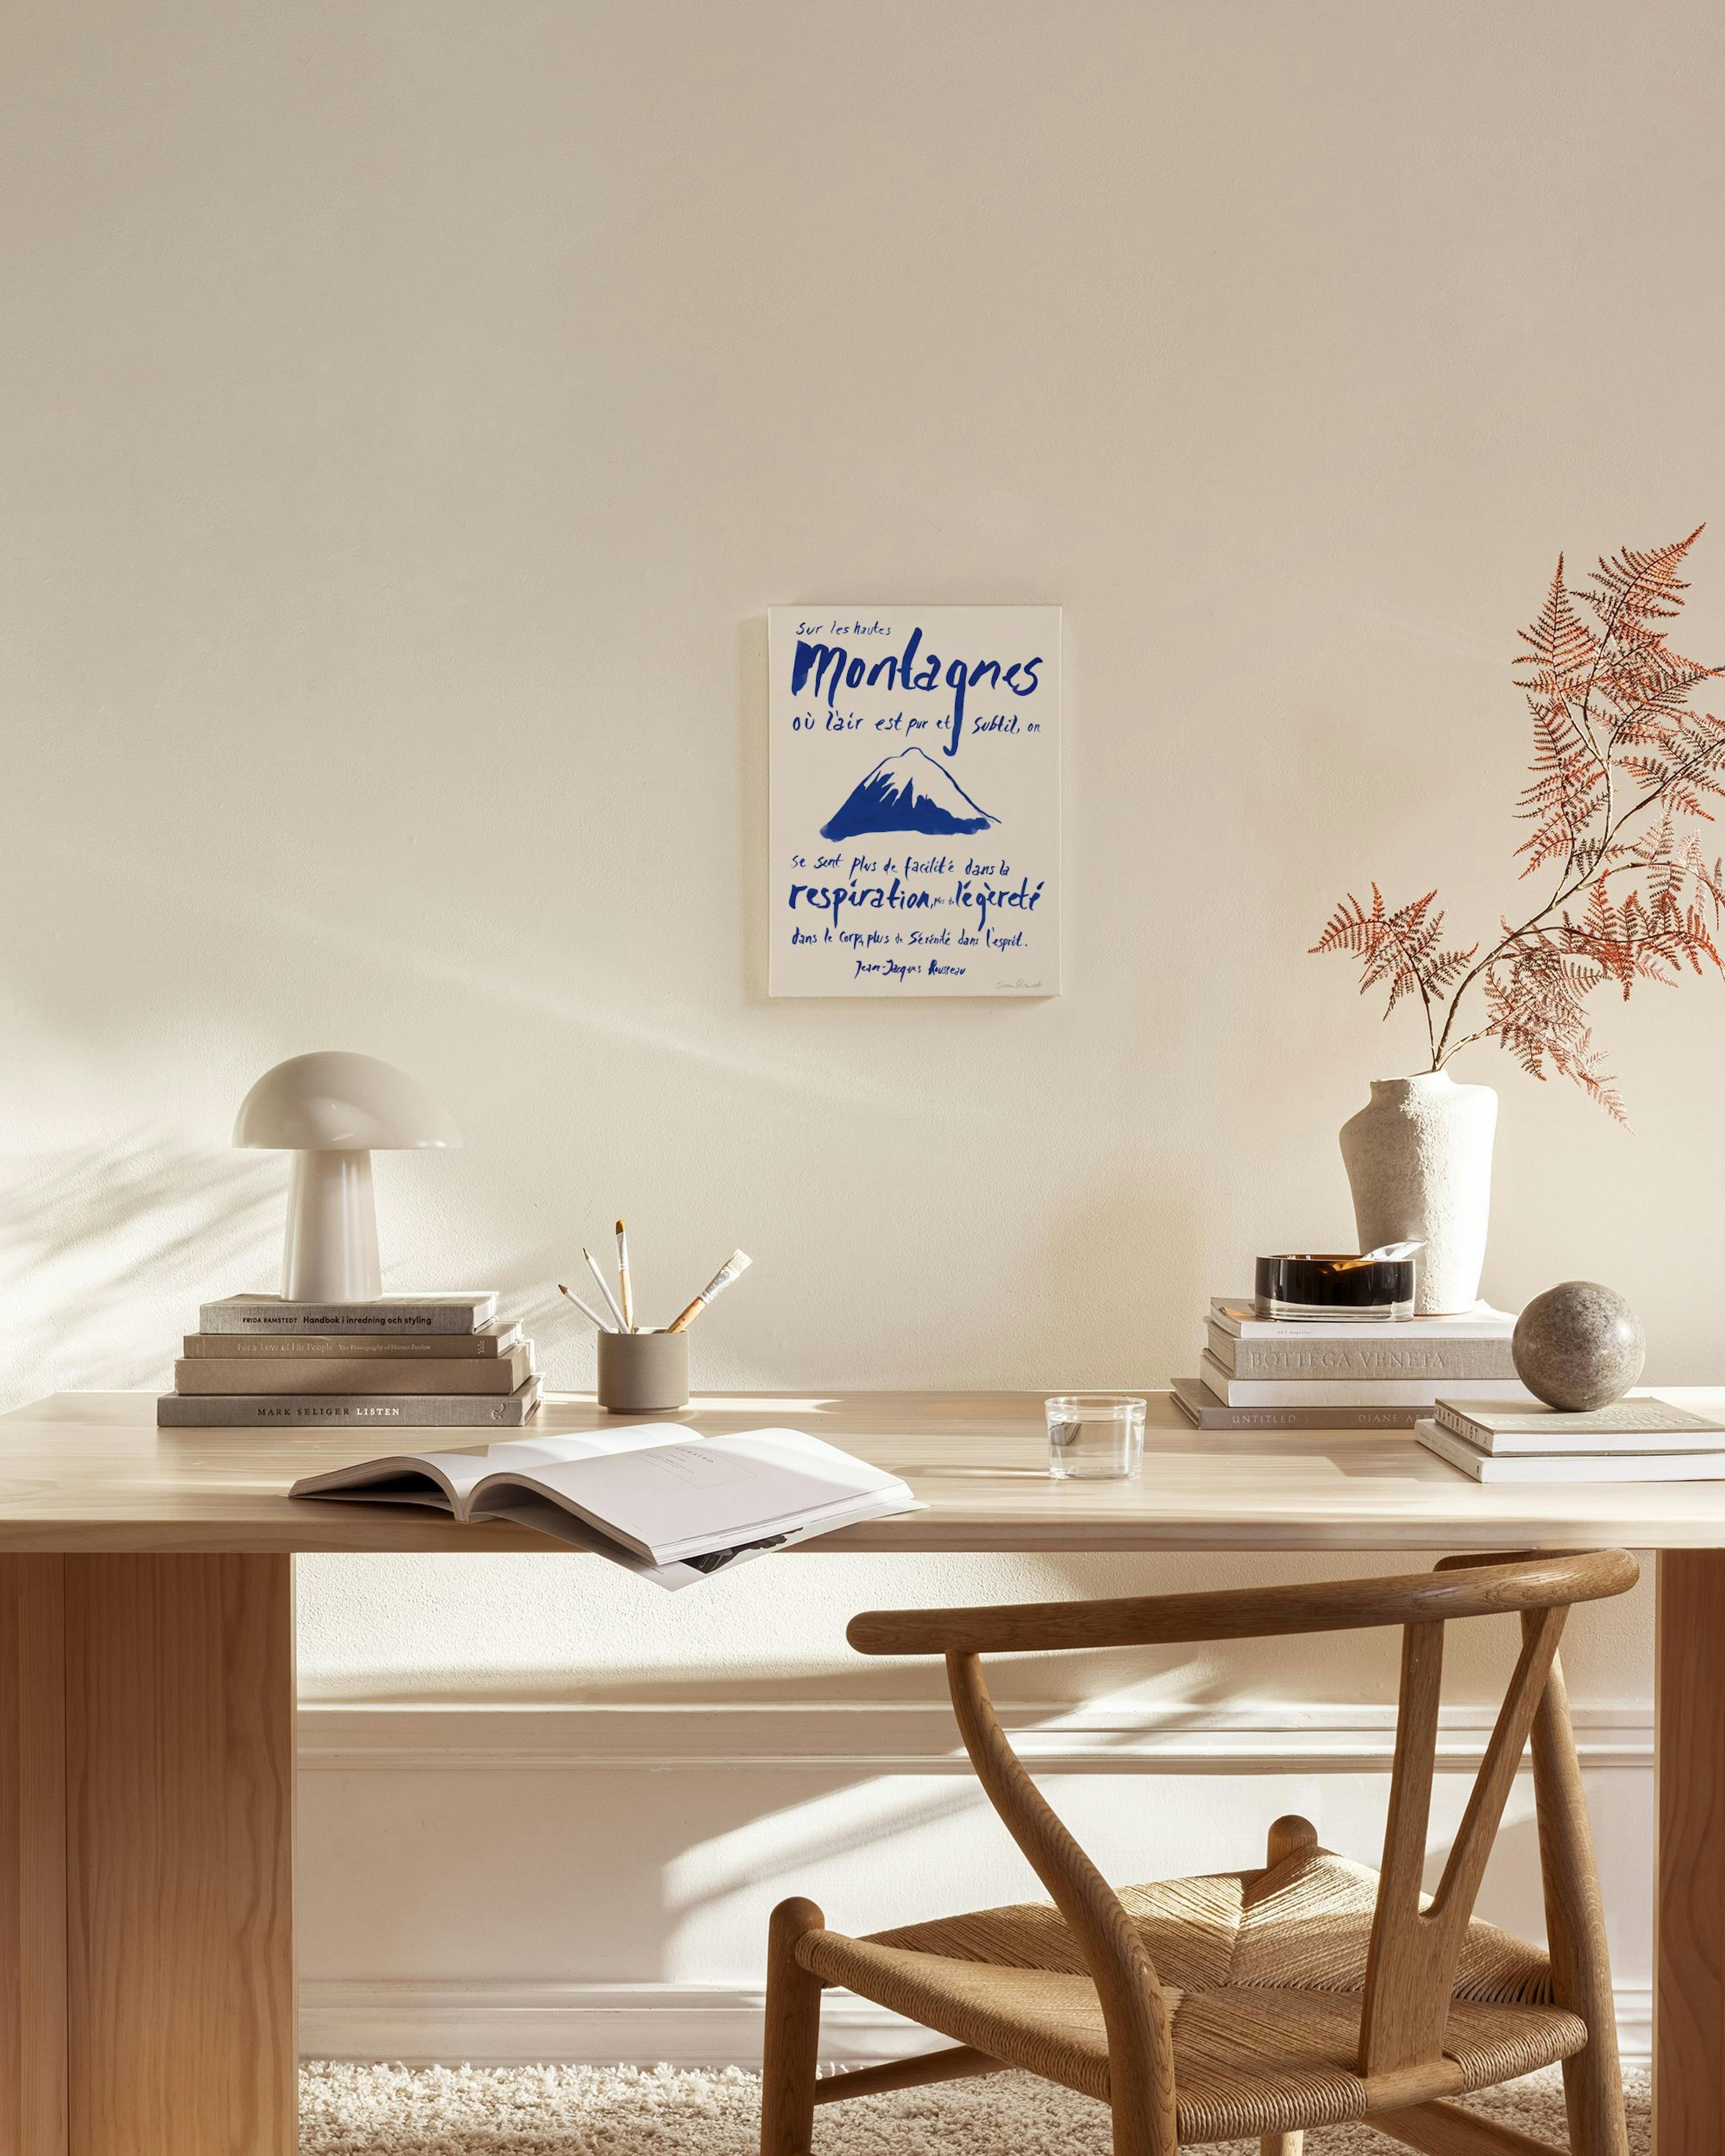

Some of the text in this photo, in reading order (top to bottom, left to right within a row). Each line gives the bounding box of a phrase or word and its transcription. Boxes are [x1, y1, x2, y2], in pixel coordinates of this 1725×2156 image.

[795, 620, 891, 636] Sur les hautes
[792, 712, 815, 731] où
[875, 711, 903, 731] est
[905, 718, 929, 737] pur
[935, 715, 951, 729] et
[1027, 722, 1041, 733] on
[848, 856, 877, 879] plus
[883, 857, 898, 875] de
[904, 856, 955, 881] facilité
[964, 857, 995, 876] dans
[999, 859, 1011, 876] la
[788, 877, 934, 929] respiration,
[955, 877, 1044, 932] légèreté
[791, 927, 818, 945] dans
[824, 927, 833, 942] le
[866, 929, 890, 948] plus
[894, 933, 903, 944] de
[957, 928, 979, 946] dans
[986, 927, 1028, 952] l'esprit.
[927, 959, 967, 976] Rousseau
[303, 1317, 340, 1325] Handbok
[341, 1316, 345, 1324] i
[346, 1316, 385, 1326] inredning
[404, 1317, 432, 1326] styling
[1251, 1352, 1445, 1368] BOTTEGA VENETA
[1232, 1414, 1296, 1423] UNTITLED
[1358, 1414, 1398, 1423] DIANE
